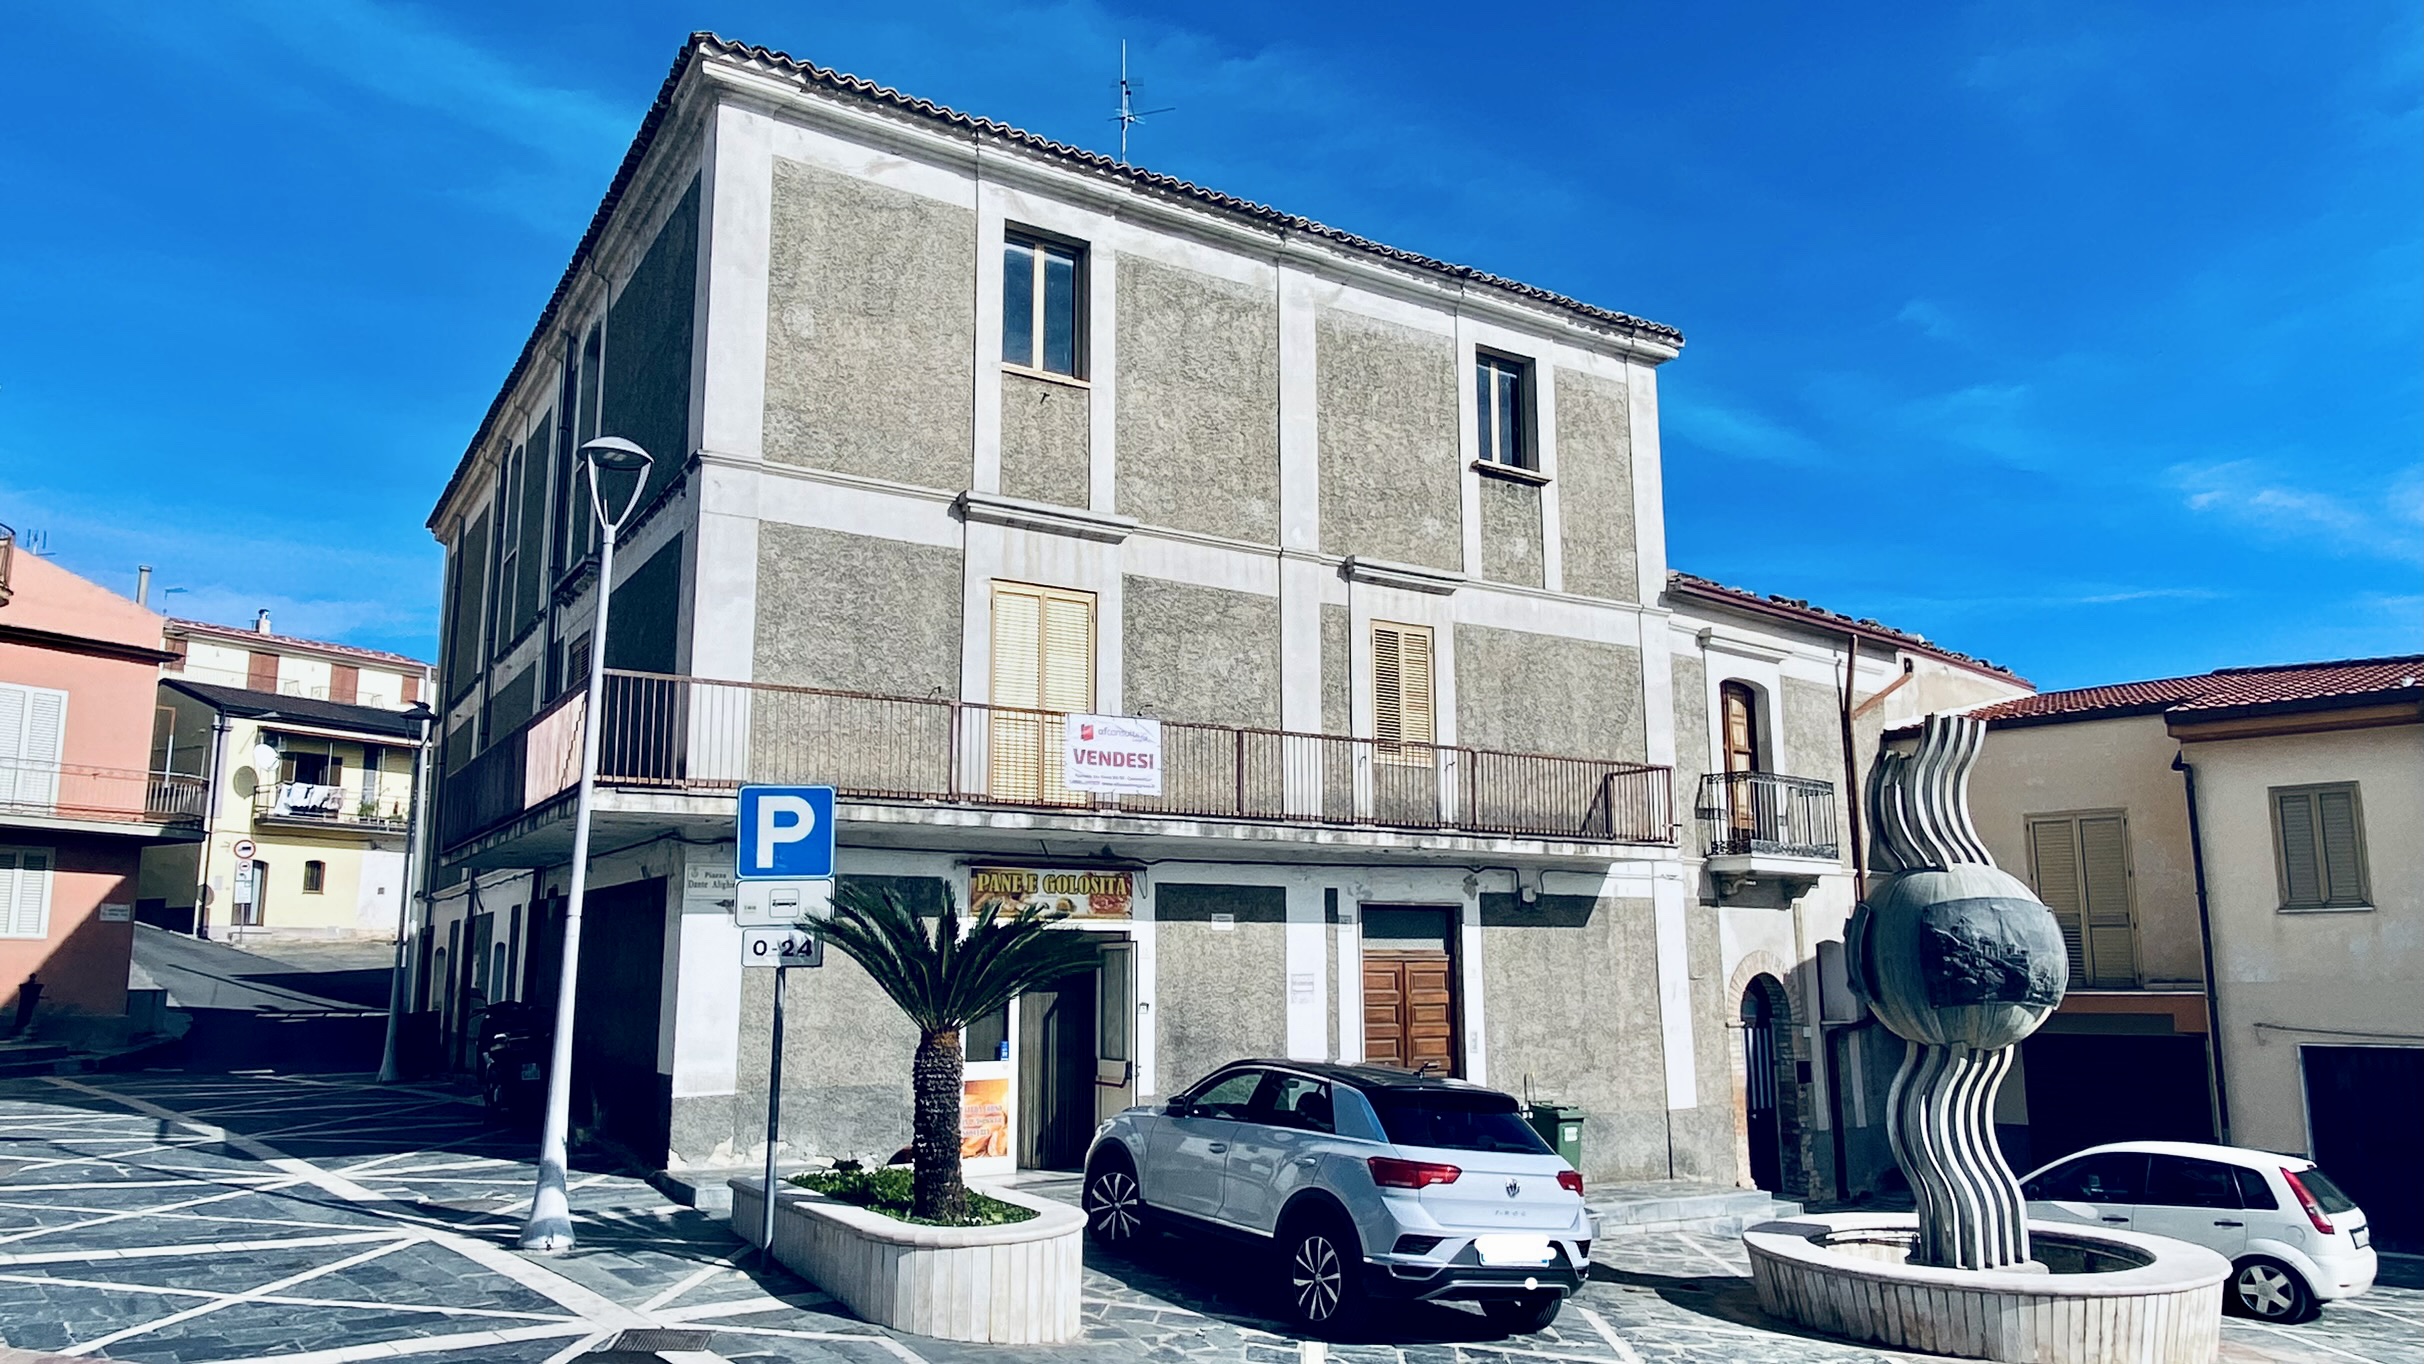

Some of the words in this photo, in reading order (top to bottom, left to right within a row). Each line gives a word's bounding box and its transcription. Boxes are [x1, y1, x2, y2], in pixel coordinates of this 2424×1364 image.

[1073, 748, 1154, 770] VENDESI
[756, 795, 816, 869] P
[688, 880, 708, 889] Dante
[976, 872, 1023, 893] PANE
[1026, 873, 1038, 894] E
